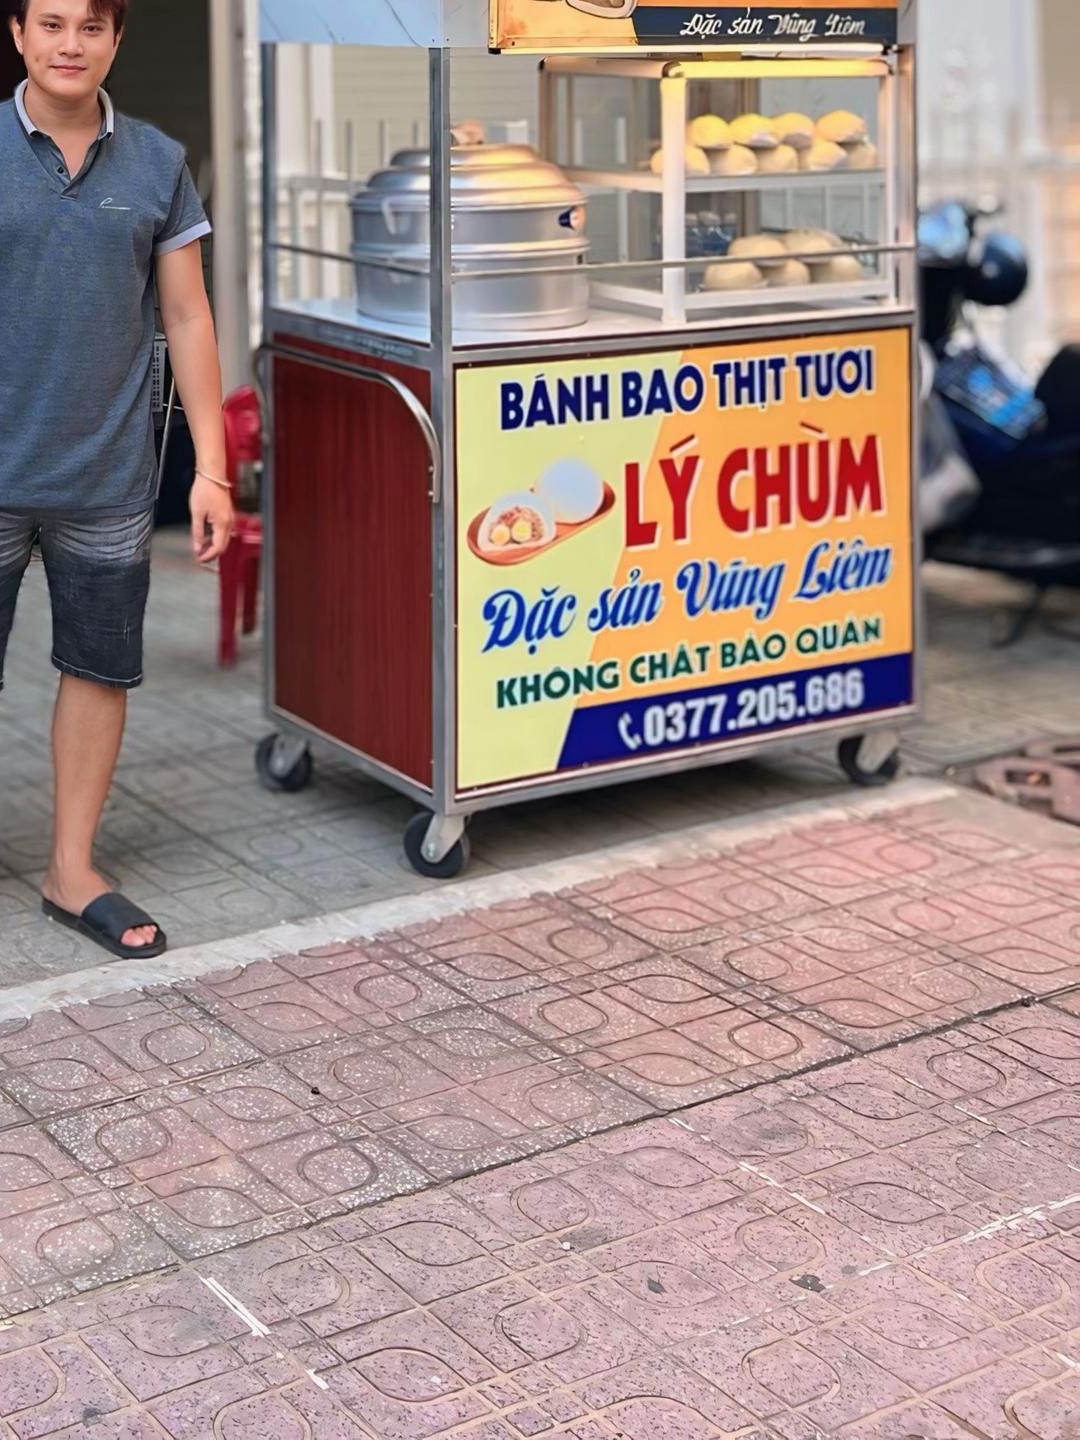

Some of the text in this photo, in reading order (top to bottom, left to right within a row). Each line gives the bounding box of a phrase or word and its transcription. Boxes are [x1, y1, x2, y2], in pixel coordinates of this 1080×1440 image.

[500, 372, 610, 431] BÁNH
[621, 364, 704, 418] BAO
[713, 357, 786, 409] THỊT
[624, 421, 884, 548] LÝ CHÙM
[481, 585, 577, 655] Đặc
[587, 568, 662, 633] sản
[795, 539, 892, 599] Liêm
[496, 663, 620, 709] KHÔNG
[642, 668, 865, 748] 0377.205.686
